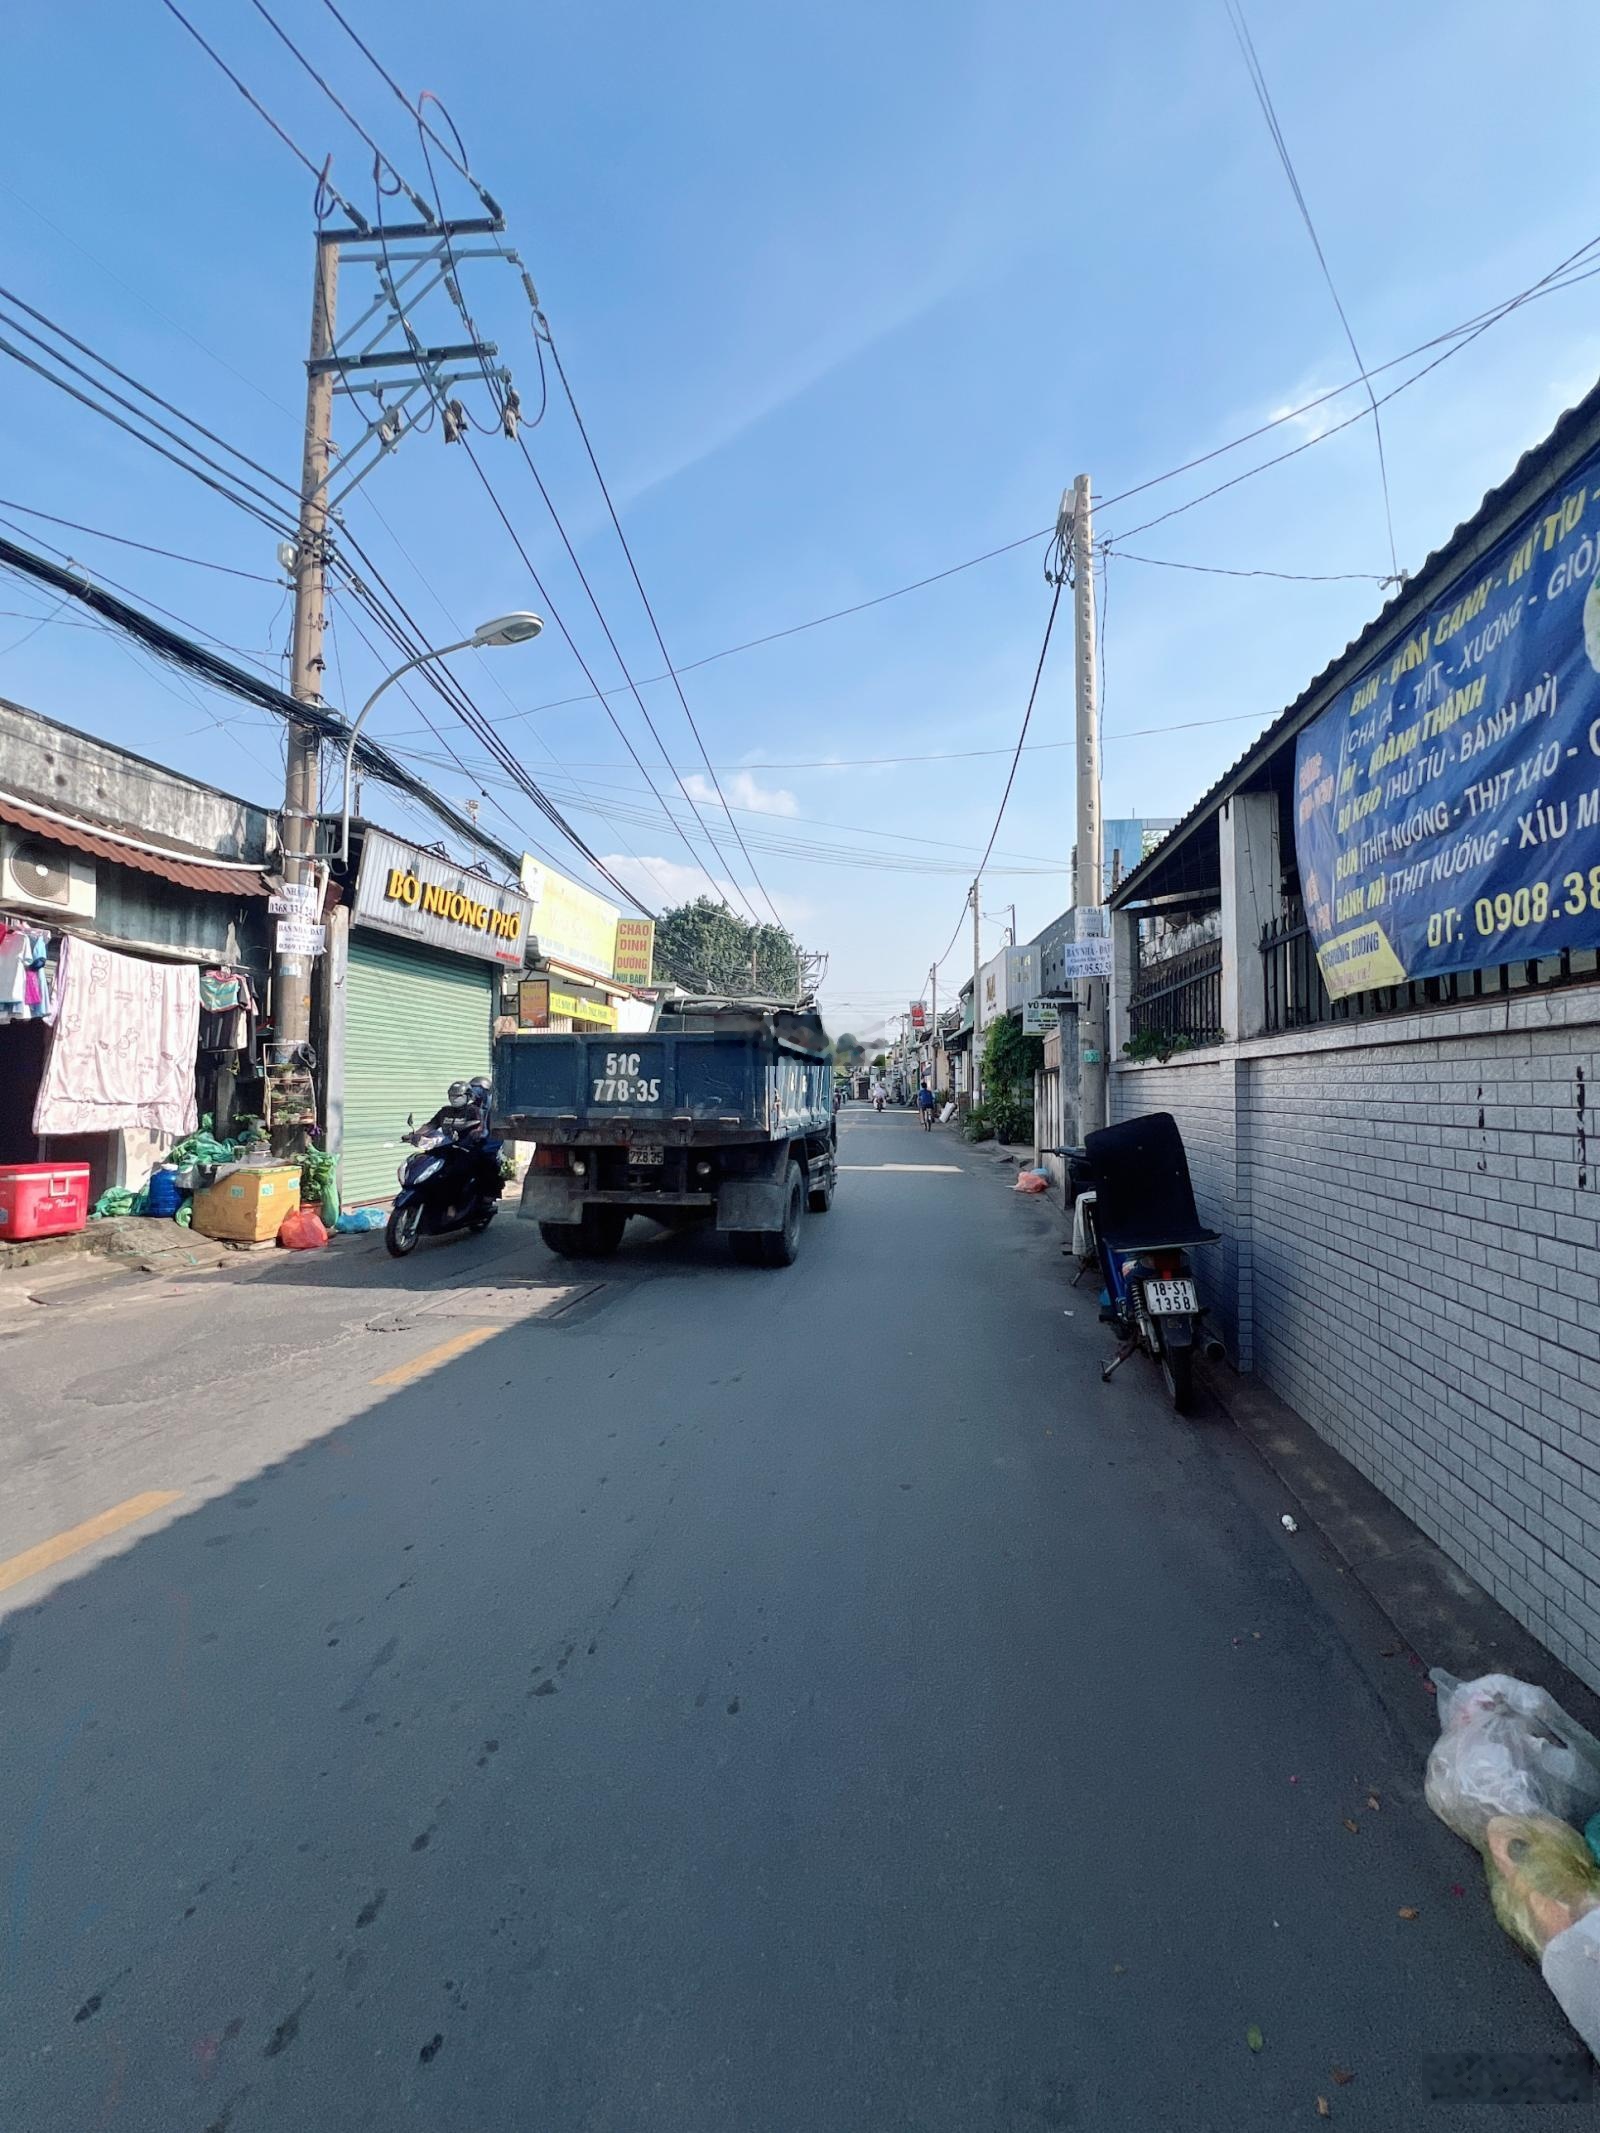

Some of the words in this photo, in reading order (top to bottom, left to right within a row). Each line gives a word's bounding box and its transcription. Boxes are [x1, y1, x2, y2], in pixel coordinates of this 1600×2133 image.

[1422, 674, 1487, 742] THÁNH
[1460, 714, 1517, 763] BÁNH
[1464, 768, 1515, 817] THỊT
[1517, 799, 1568, 849] XÍU
[388, 868, 420, 904] BÒ
[423, 882, 488, 930] NƯỚNG
[490, 910, 521, 940] PHỐ
[619, 939, 647, 952] DINH
[605, 1052, 641, 1076] 51C
[1152, 1281, 1188, 1296] 18-S1
[1155, 1296, 1191, 1311] 1358
